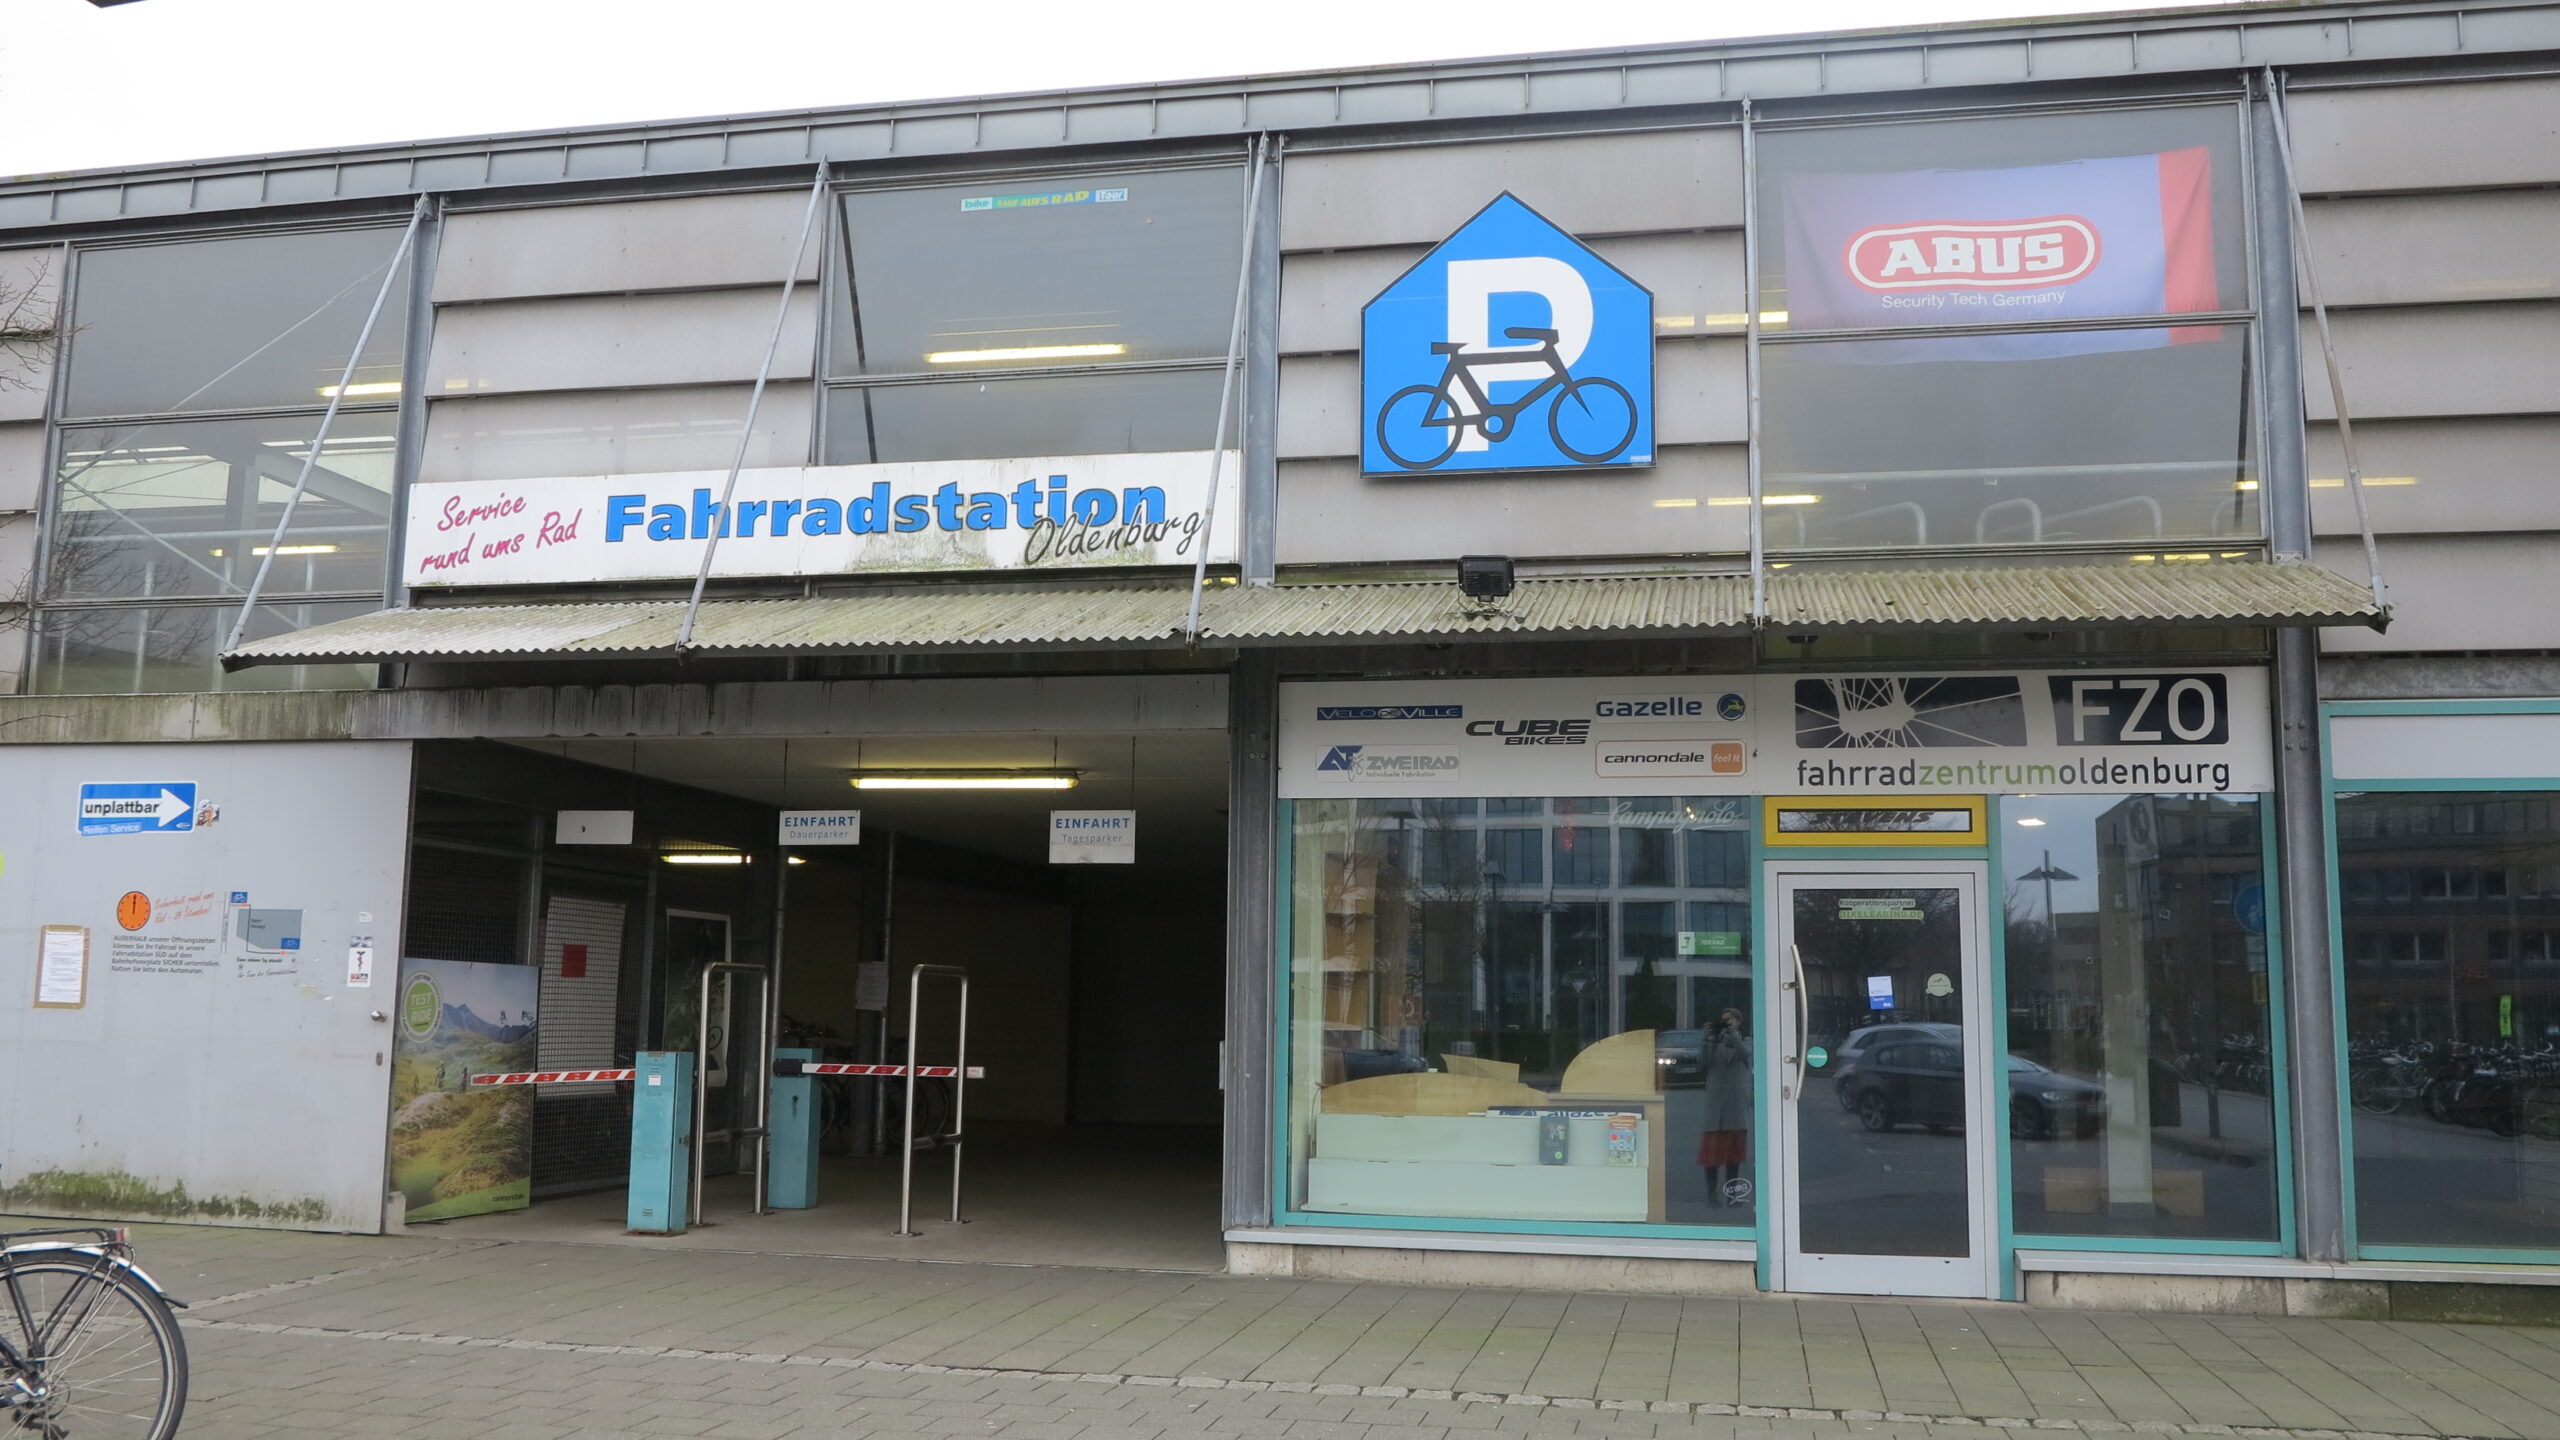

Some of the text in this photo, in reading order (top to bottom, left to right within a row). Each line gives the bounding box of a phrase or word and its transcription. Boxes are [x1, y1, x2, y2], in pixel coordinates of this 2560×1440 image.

[964, 199, 990, 209] bike
[1051, 190, 1090, 204] RAD
[1099, 190, 1125, 200] Tour
[1880, 232, 2064, 277] ABUS
[1881, 289, 2066, 310] Security Tech Germany
[1447, 256, 1594, 452] P
[437, 492, 527, 531] Service
[604, 474, 1165, 543] Fahrradstation
[419, 507, 583, 574] rund ums Rad
[1024, 503, 1204, 566] Oldenburg
[1596, 697, 1703, 717] Gazelle
[2072, 678, 2216, 742] FZO
[1465, 719, 1592, 736] CUBE
[1504, 736, 1588, 745] BIKES
[1367, 755, 1460, 770] ZWEIRAD
[1604, 752, 1705, 764] cannondale
[1713, 752, 1741, 763] feel it
[1797, 756, 2230, 791] fahrradzentrumoldenburg
[84, 800, 160, 816] unplattbar
[83, 824, 140, 834] Reifen Service
[784, 816, 855, 827] EINFAHRT
[1055, 818, 1131, 829] EINFAHRT
[789, 830, 848, 840] Dauerparker
[1062, 834, 1122, 844] Tagesparker
[1839, 899, 1914, 907] Kooperationspartner
[154, 943, 177, 951] Fahrrad
[411, 992, 432, 1006] TEST
[410, 1008, 433, 1023] RIDE
